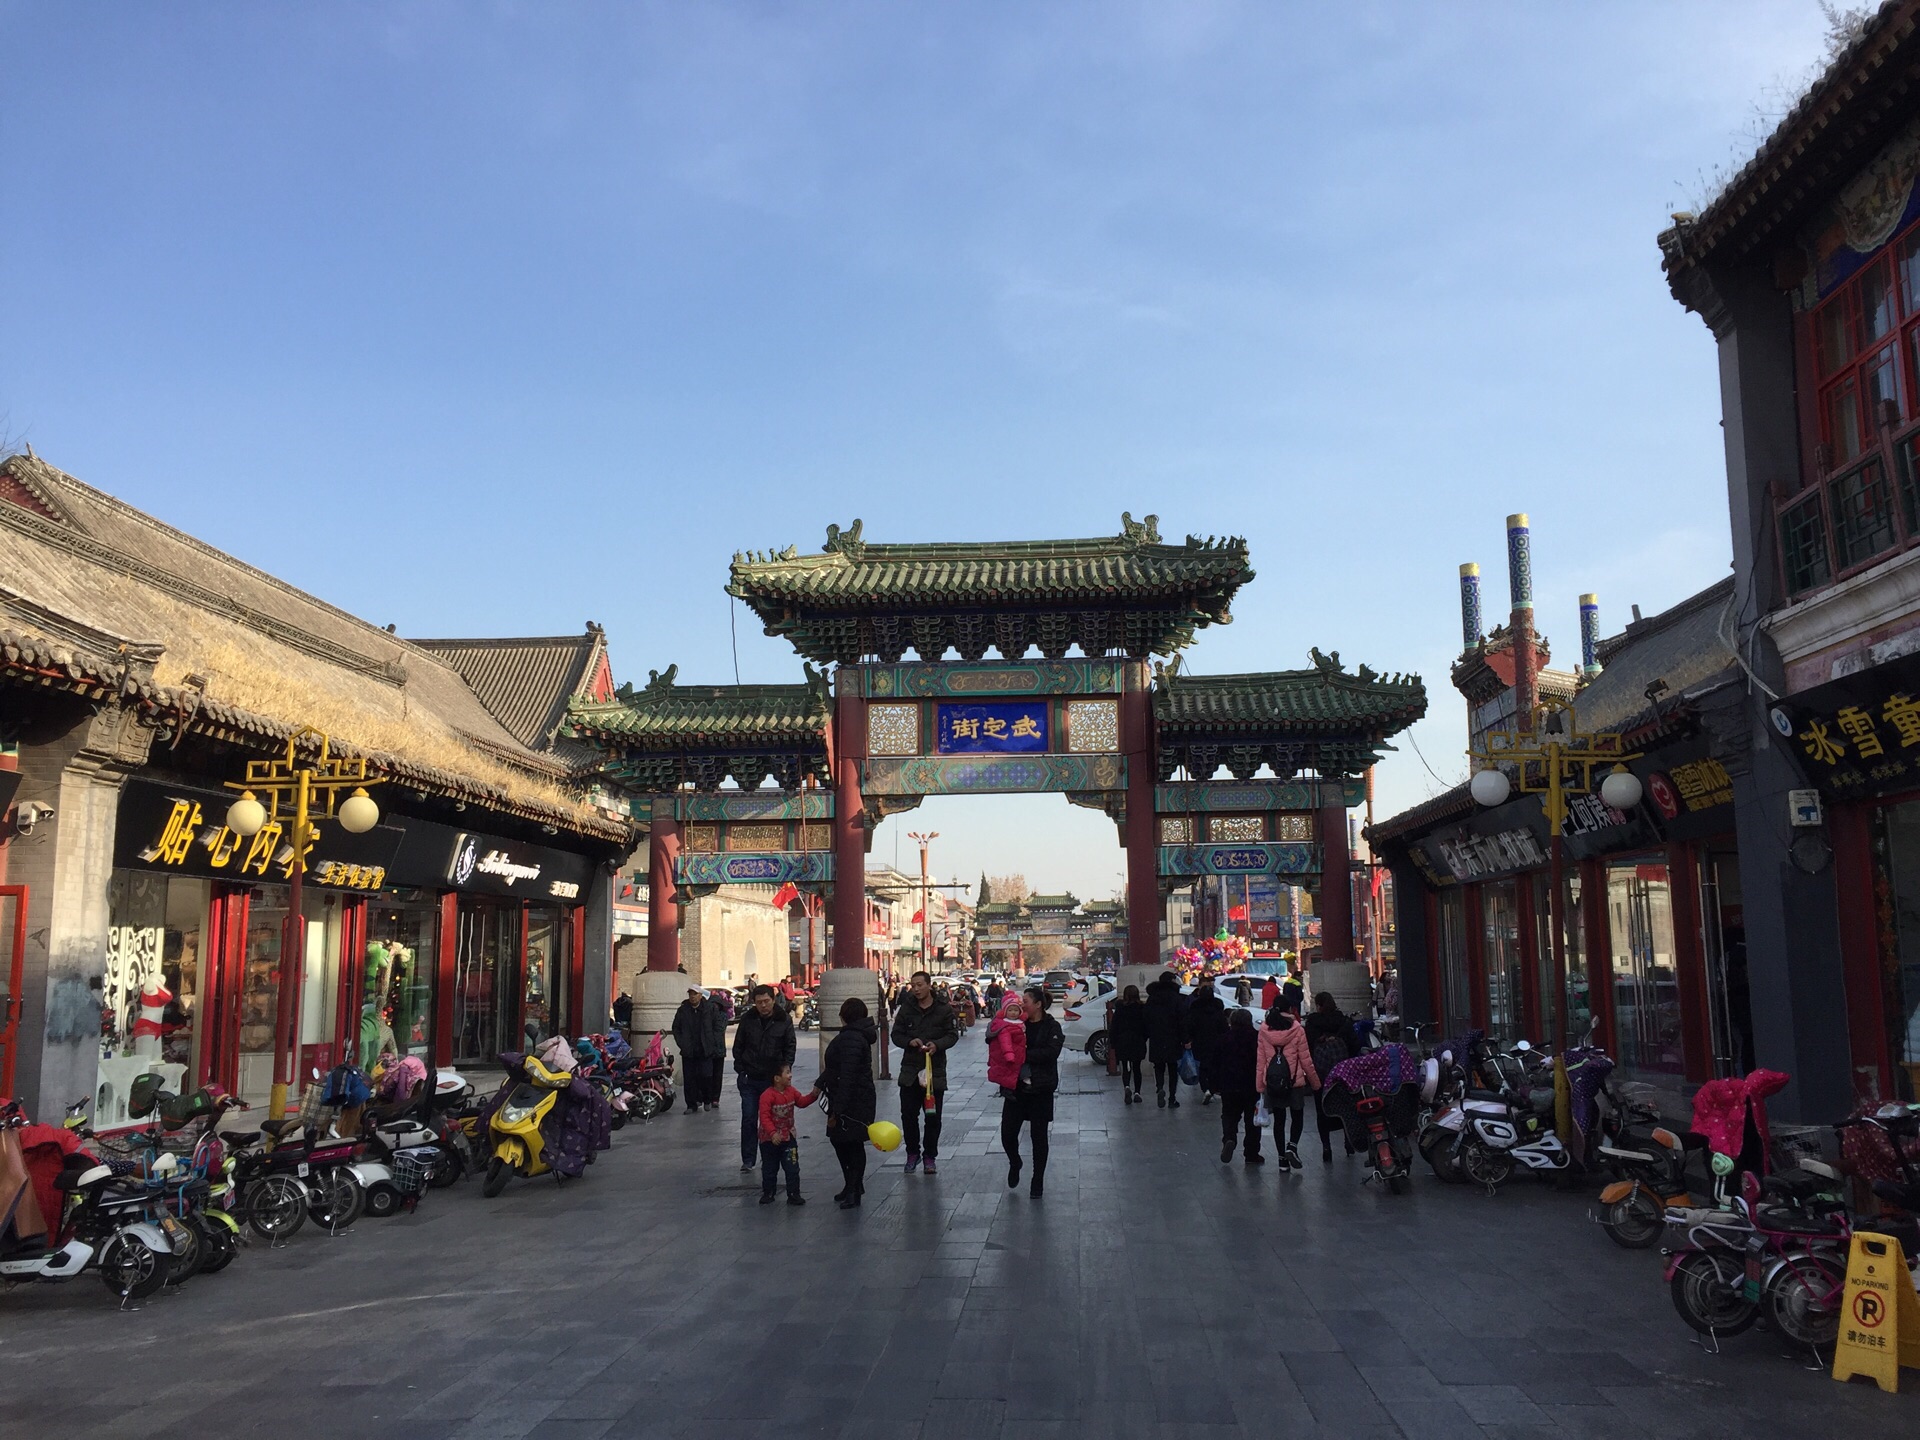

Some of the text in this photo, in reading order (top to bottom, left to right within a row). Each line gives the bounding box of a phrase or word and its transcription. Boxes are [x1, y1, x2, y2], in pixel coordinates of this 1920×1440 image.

[321, 863, 386, 890] 生活体验馆
[1257, 924, 1273, 932] KFC
[1851, 1277, 1889, 1291] NO PARKING
[1847, 1329, 1887, 1349] 请勿泊车
